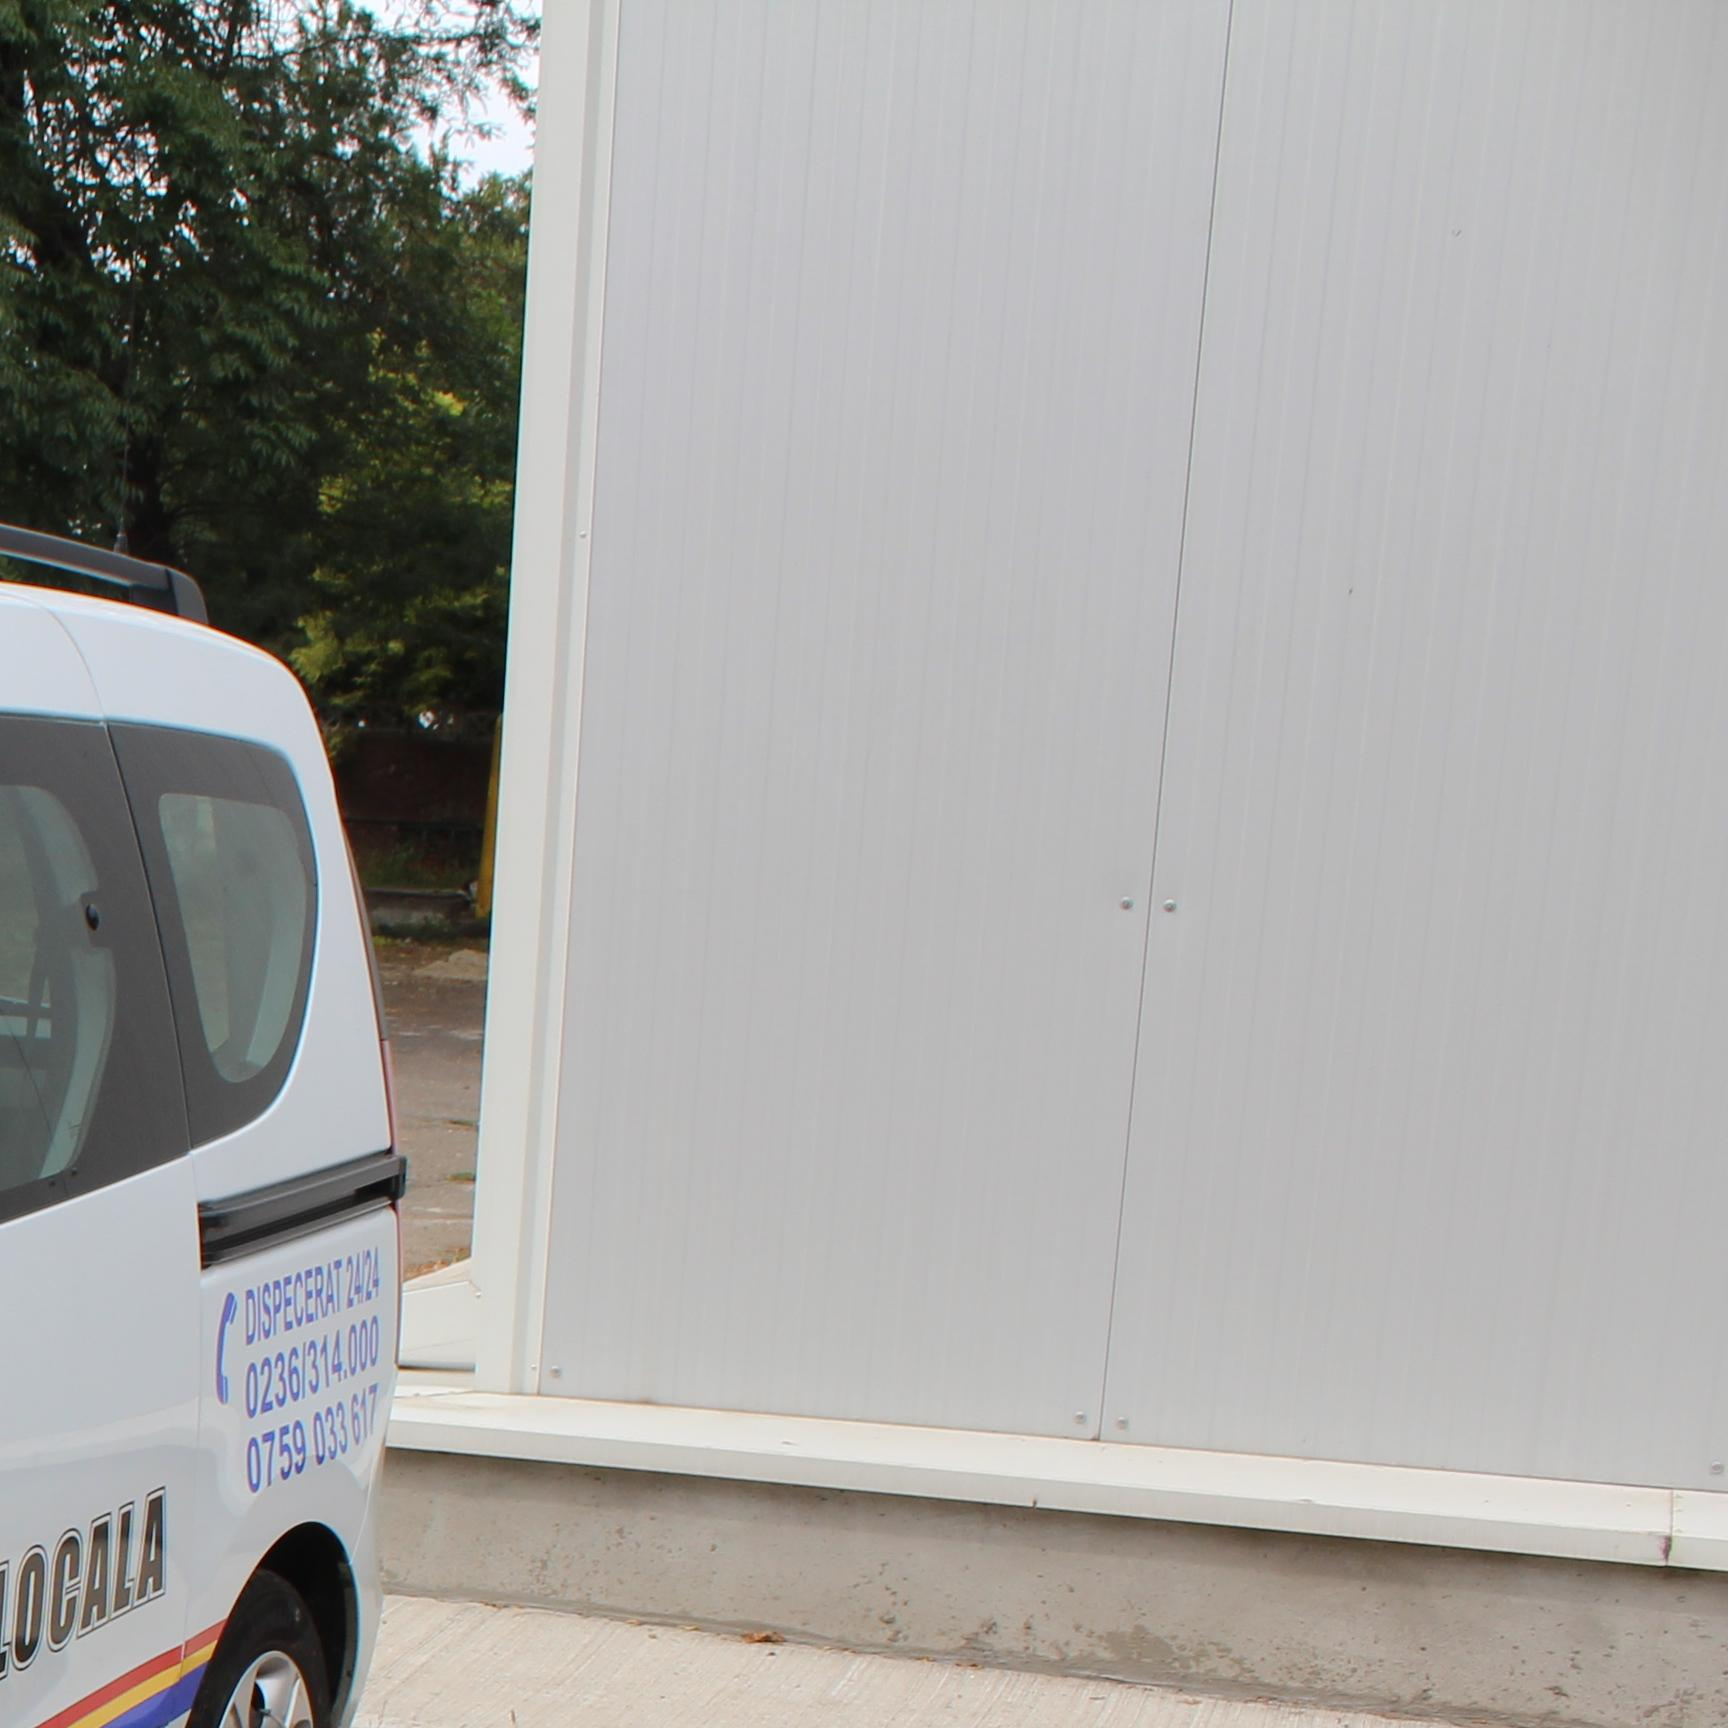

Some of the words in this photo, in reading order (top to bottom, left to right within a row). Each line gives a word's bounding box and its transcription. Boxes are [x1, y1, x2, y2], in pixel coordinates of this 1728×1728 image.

[244, 1257, 343, 1346] DISPECERAT
[345, 1246, 381, 1310] 24/24
[244, 1314, 381, 1420] 0236/314.000
[246, 1419, 308, 1494] 0759
[312, 1400, 348, 1467] 033
[350, 1382, 380, 1447] 617
